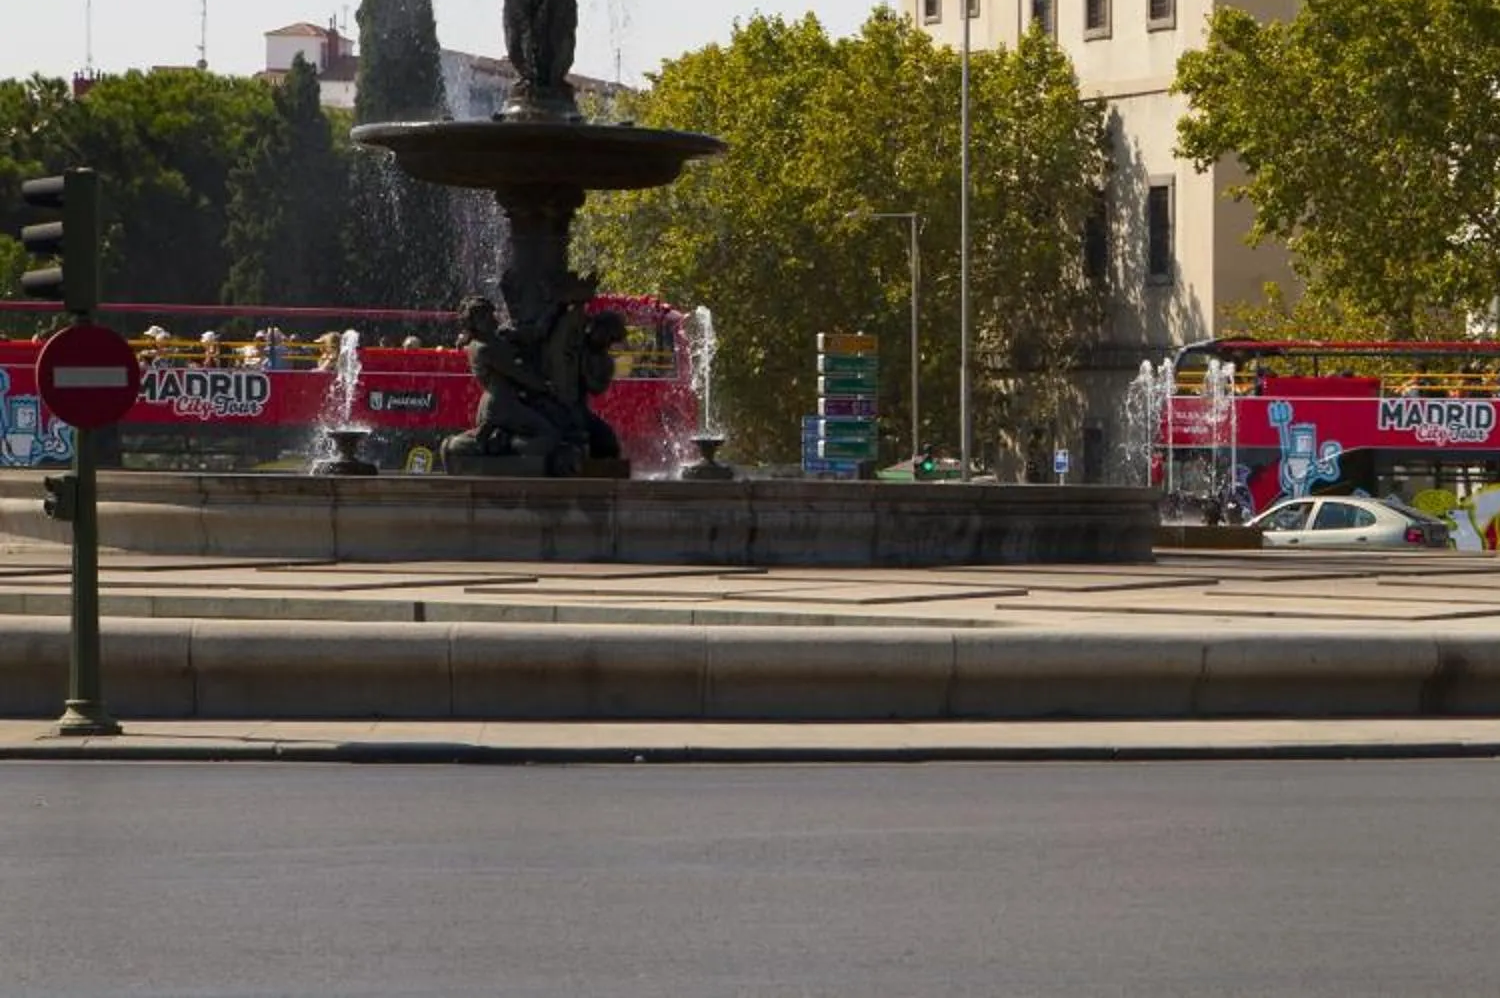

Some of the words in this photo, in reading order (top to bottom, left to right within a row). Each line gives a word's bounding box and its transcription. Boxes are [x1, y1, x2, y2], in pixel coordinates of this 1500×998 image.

[176, 396, 213, 418] City
[214, 396, 260, 415] Tour
[1380, 402, 1494, 429] MADRID
